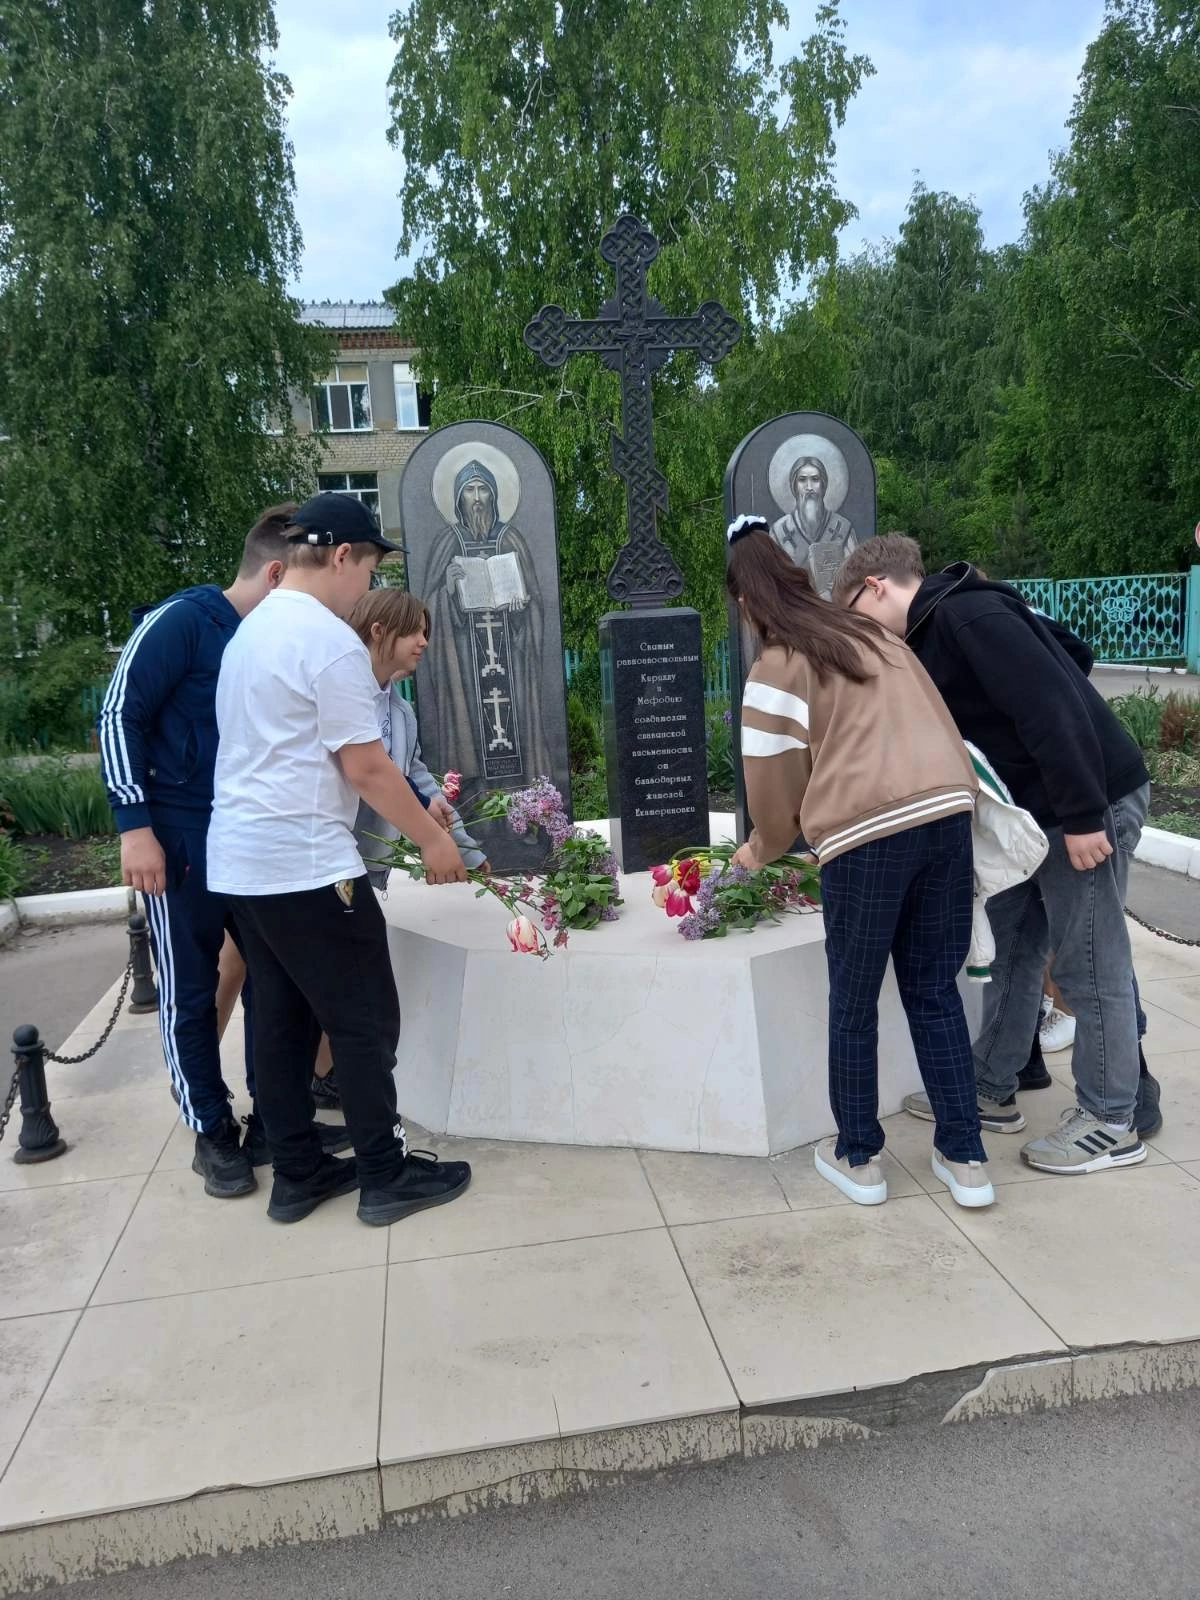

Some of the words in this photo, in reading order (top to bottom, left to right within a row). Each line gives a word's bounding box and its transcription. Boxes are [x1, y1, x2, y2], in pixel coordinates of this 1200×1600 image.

[640, 642, 675, 651] Святым
[640, 673, 677, 683] Кириллу
[637, 695, 683, 706] Мефодию
[637, 729, 686, 740] славянской
[632, 747, 693, 757] письменности
[634, 775, 692, 785] благодарных
[645, 790, 684, 800] жителей
[635, 806, 696, 817] Екатериновки
